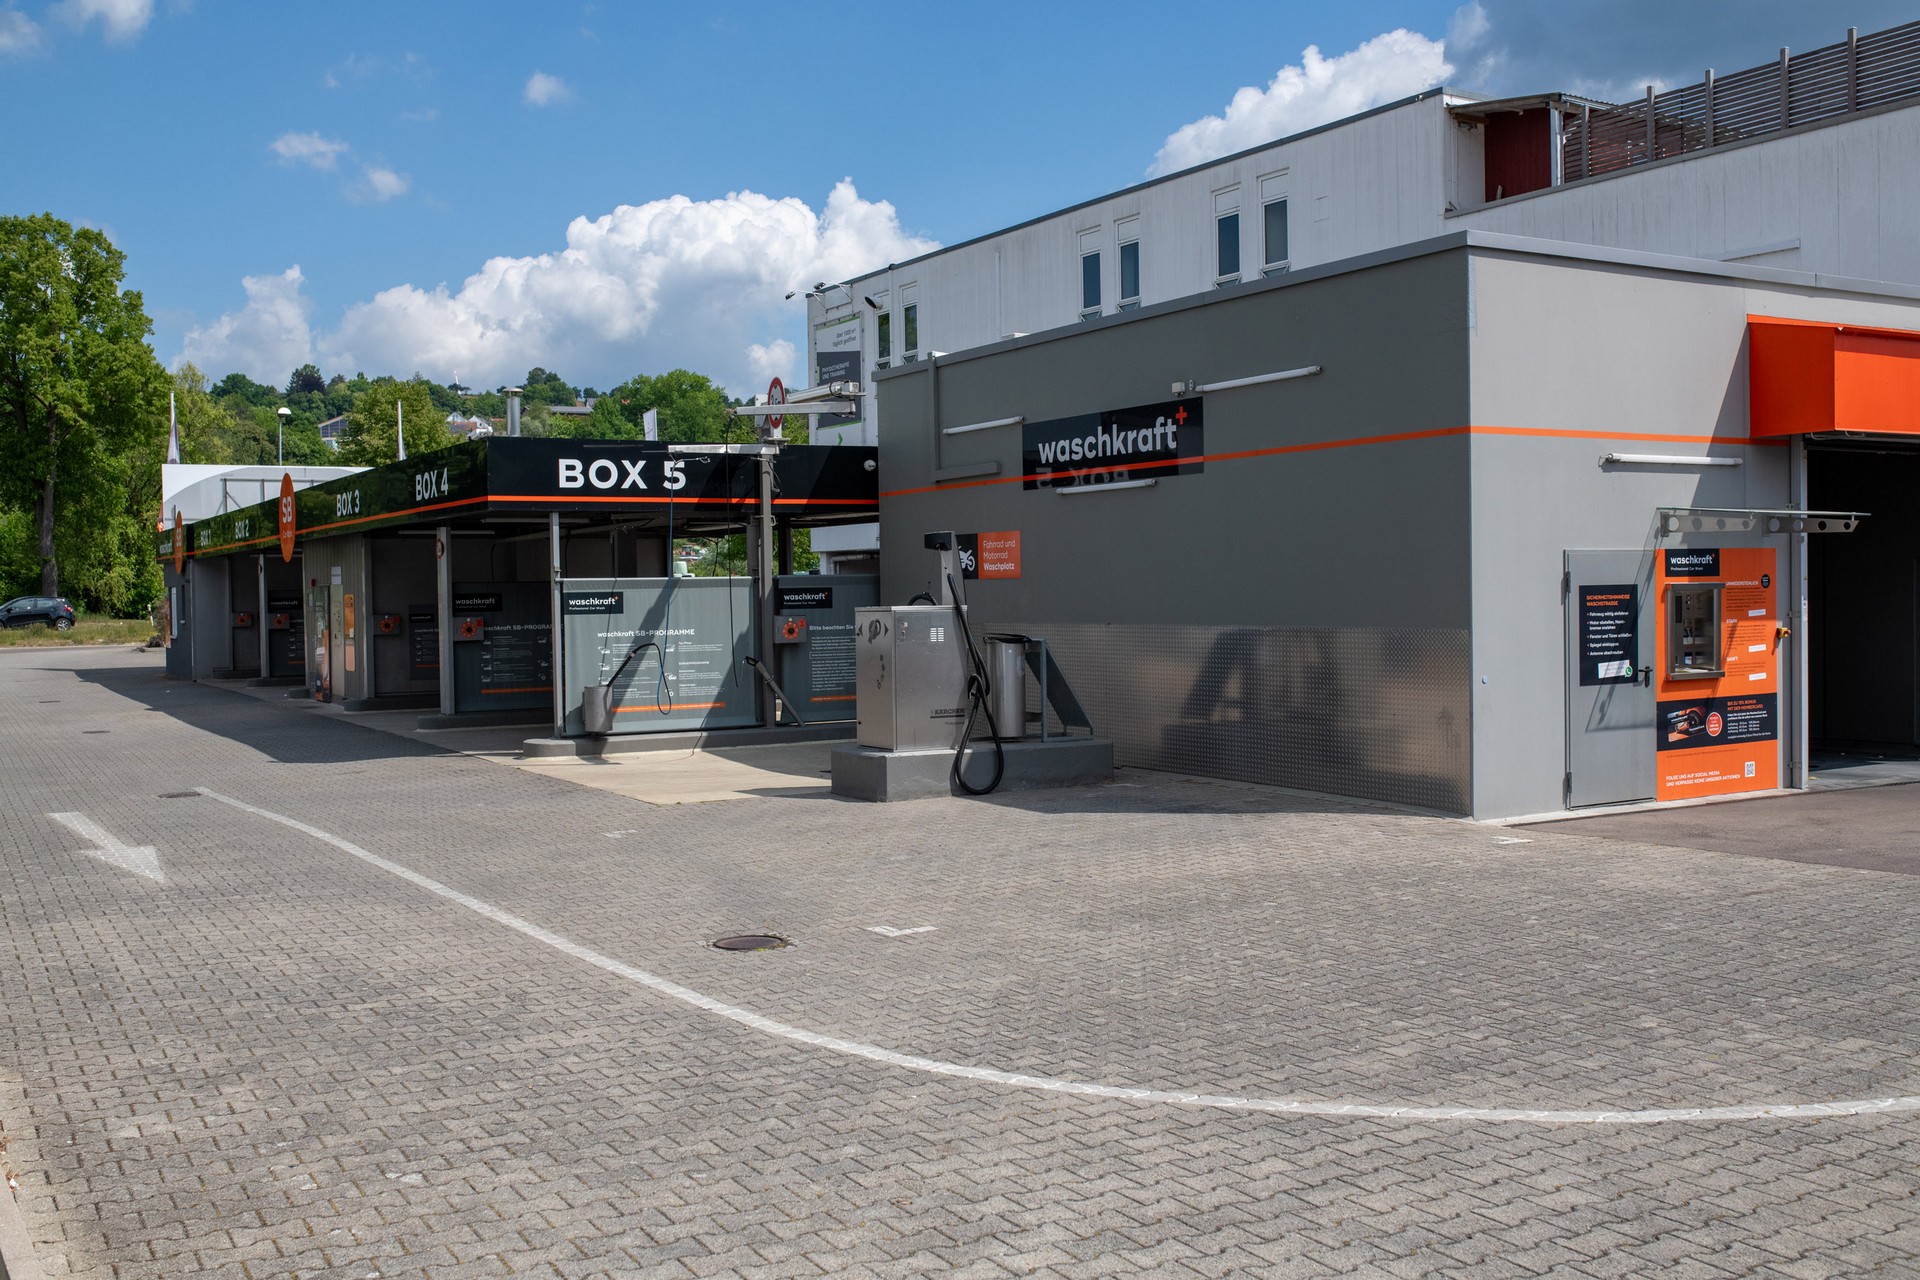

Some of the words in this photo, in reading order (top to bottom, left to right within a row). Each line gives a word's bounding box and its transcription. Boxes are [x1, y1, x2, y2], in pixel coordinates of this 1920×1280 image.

[1038, 416, 1177, 464] waschkraft
[415, 474, 437, 501] BOX
[440, 467, 449, 496] 4
[558, 458, 648, 489] BOX
[663, 460, 686, 490] 5
[282, 496, 292, 523] SB
[336, 494, 351, 517] BOX
[352, 490, 360, 514] 3
[235, 520, 245, 539] BOX
[245, 519, 249, 537] 2
[983, 540, 1004, 549] Fahrrad
[984, 562, 1014, 571] Waschplatz
[1671, 555, 1712, 564] waschkraft
[569, 597, 615, 606] waschkraft
[636, 629, 695, 637] SB-PROGRAMME
